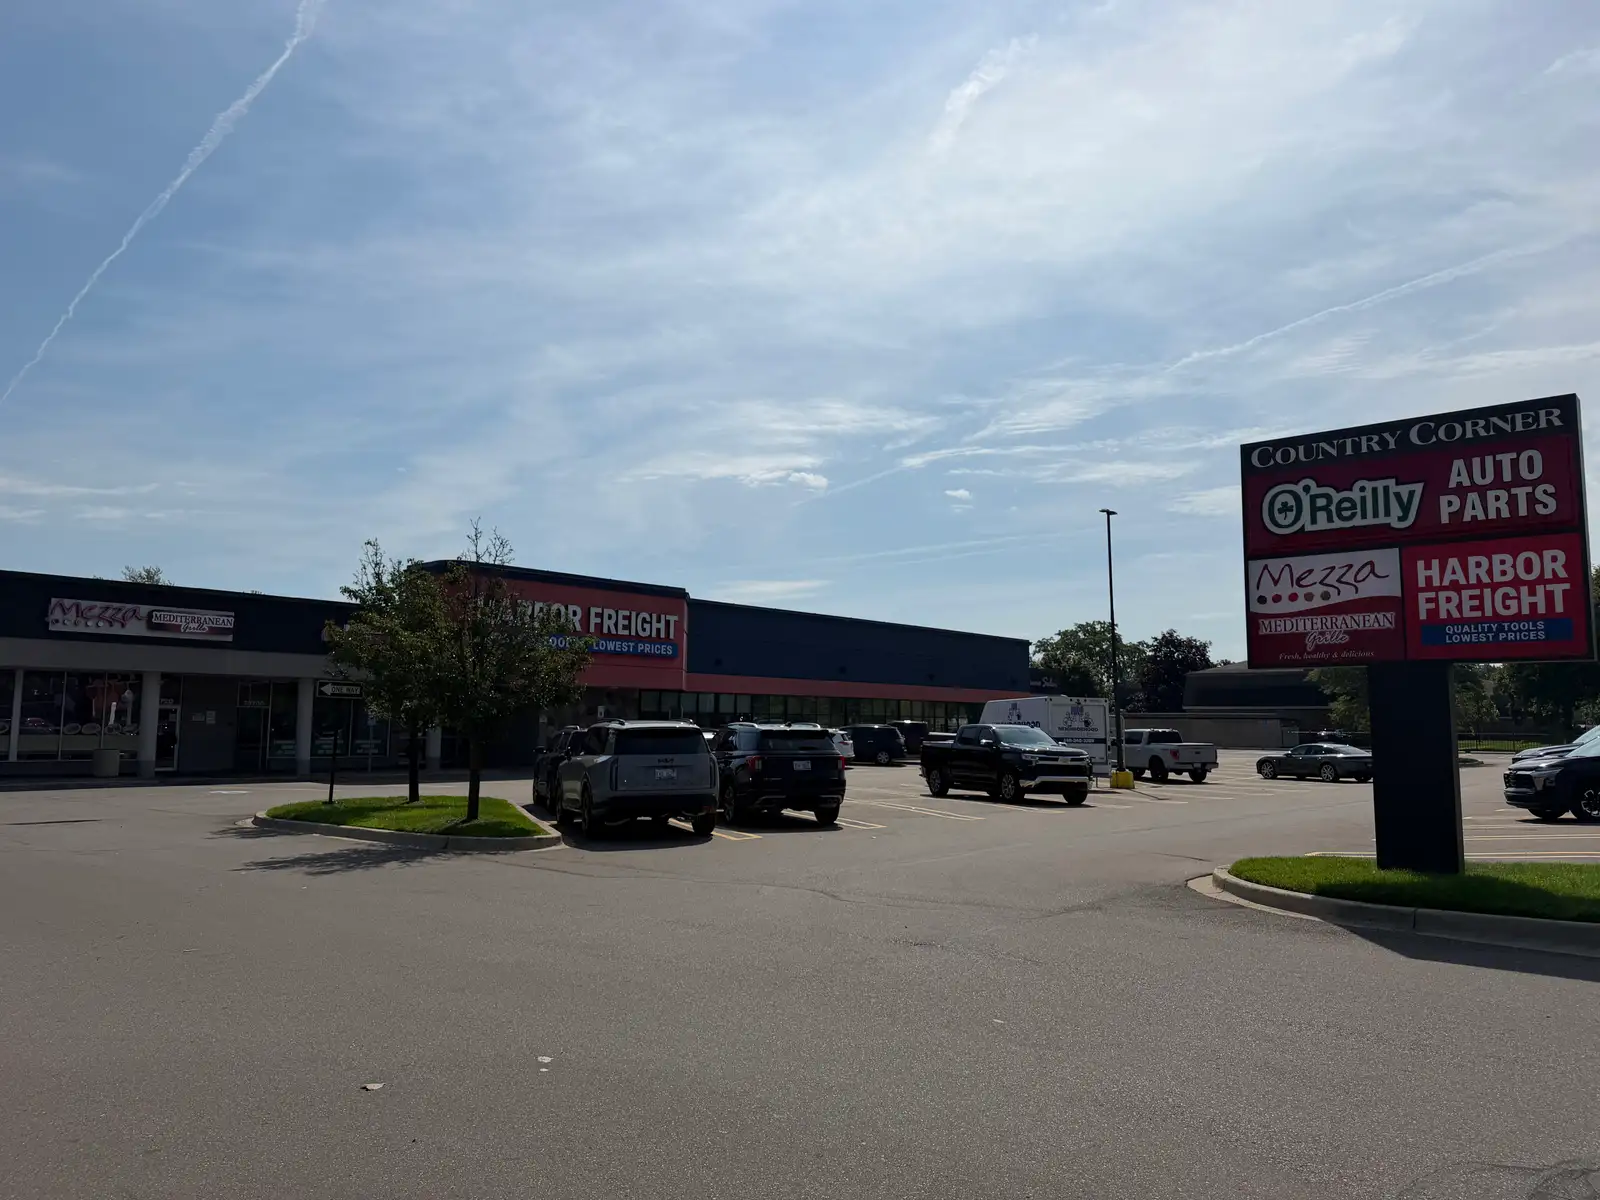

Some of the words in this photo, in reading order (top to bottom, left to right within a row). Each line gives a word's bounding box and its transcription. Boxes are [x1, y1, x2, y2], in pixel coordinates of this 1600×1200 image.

[1250, 430, 1403, 469] COUNTRY
[1409, 408, 1564, 446] CORNER
[1448, 448, 1543, 489] AUTO
[1267, 484, 1416, 529] O'Reilly
[1439, 484, 1557, 524] PARTS
[1256, 560, 1389, 596] Mezza
[1416, 549, 1568, 588] HARBOR
[1418, 583, 1571, 620] FREIGHT
[152, 612, 235, 627] MEDITERRANEAN
[589, 606, 679, 640] FREIGHT
[1258, 611, 1396, 635] MEDITERRANEAN
[1445, 622, 1501, 634] QUALITY
[1503, 621, 1545, 632] TOOLS
[592, 638, 635, 652] LOWEST
[638, 643, 673, 655] PRICES
[1305, 631, 1350, 651] Grille
[1446, 633, 1496, 643] LOWEST
[1499, 631, 1546, 641] PRICES
[1279, 651, 1302, 660] Fresh,
[1303, 650, 1331, 661] healthy
[1332, 651, 1339, 659] &
[1340, 649, 1375, 658] delicious
[345, 686, 359, 694] WAY
